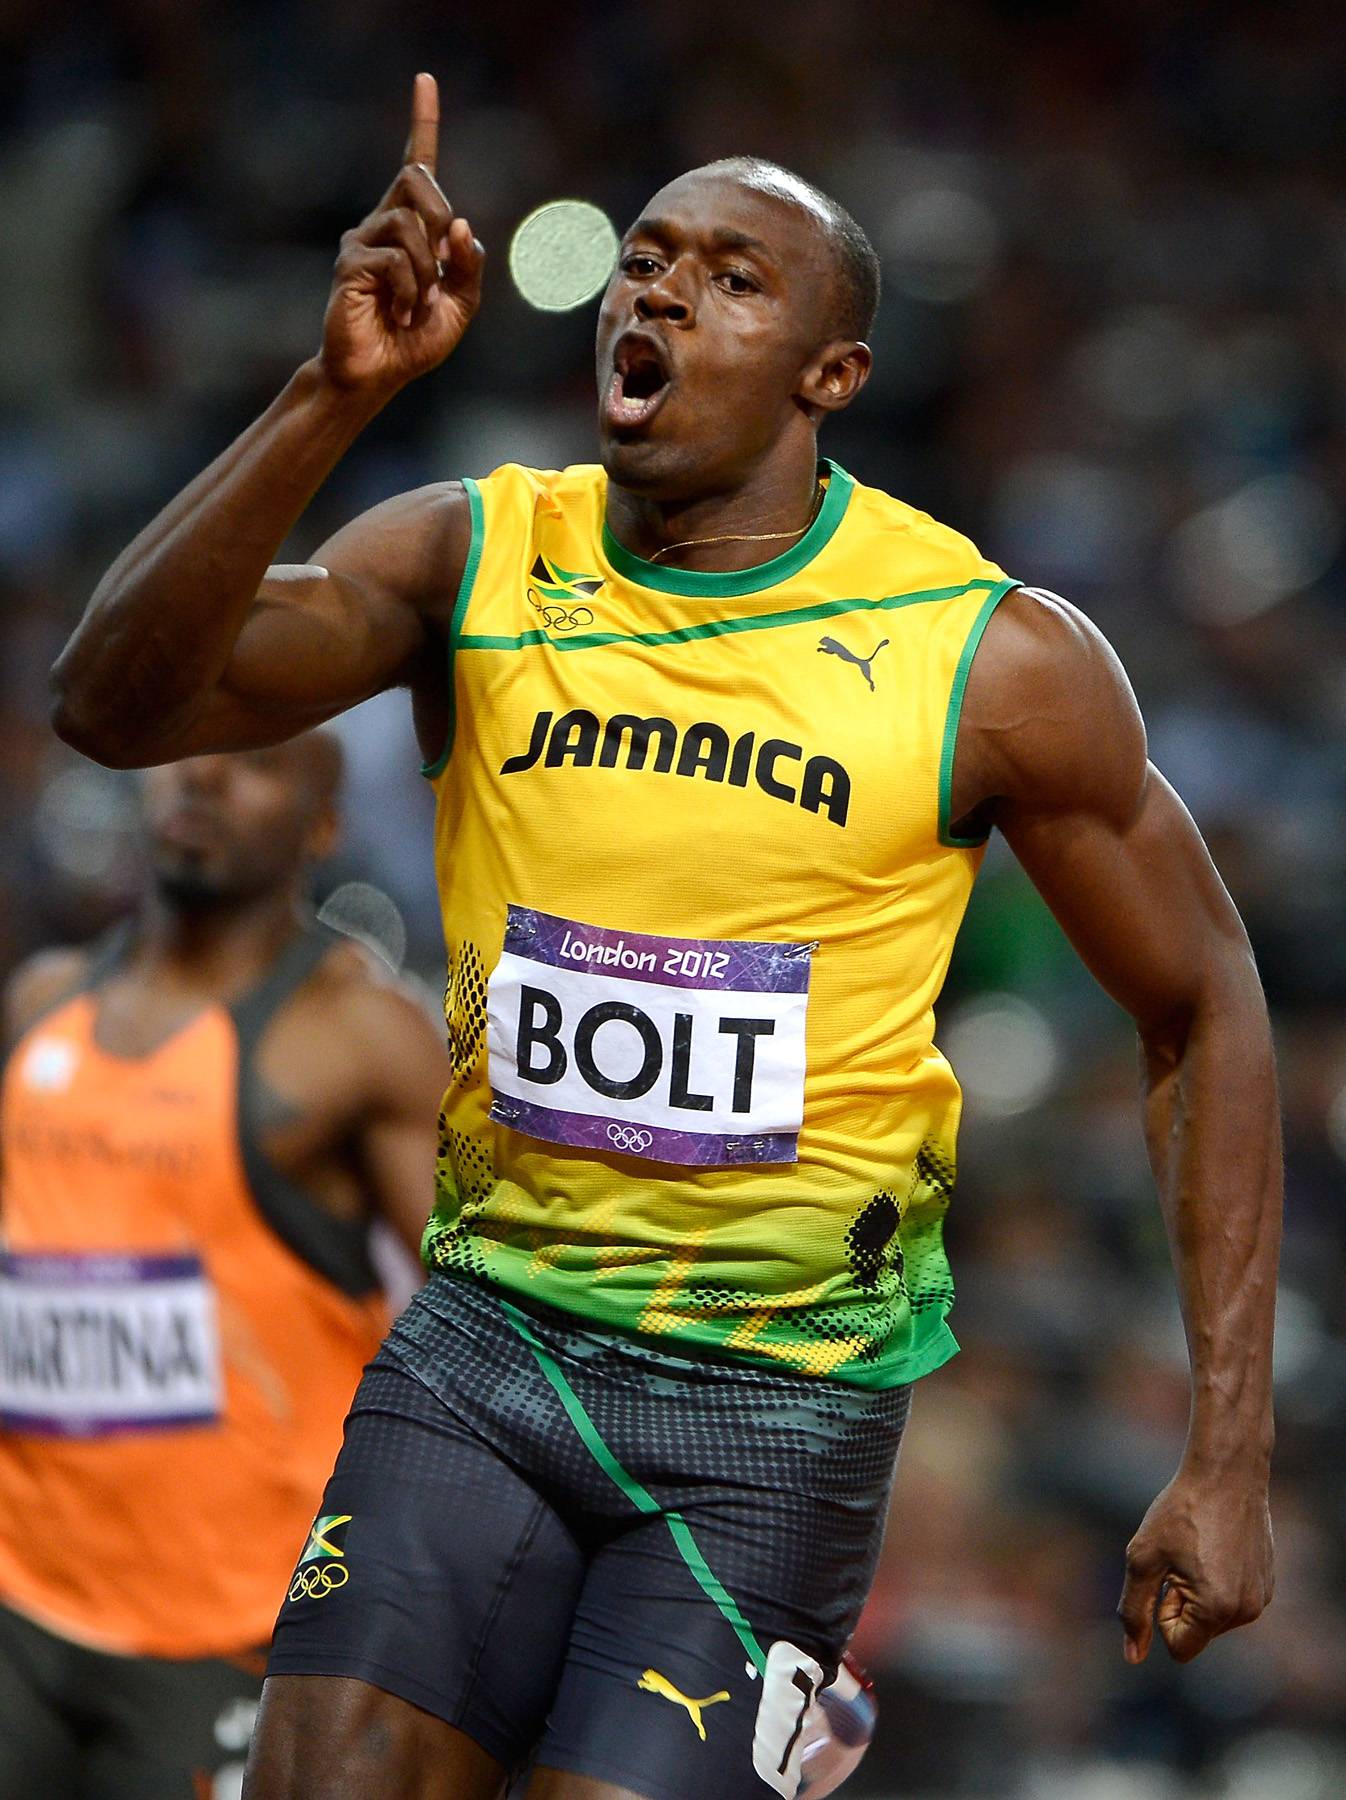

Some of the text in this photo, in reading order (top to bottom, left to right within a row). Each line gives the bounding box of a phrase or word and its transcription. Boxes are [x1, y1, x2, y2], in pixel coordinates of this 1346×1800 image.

[500, 708, 851, 828] JAMAICA
[559, 930, 731, 979] London 2012
[516, 983, 776, 1114] BOLT
